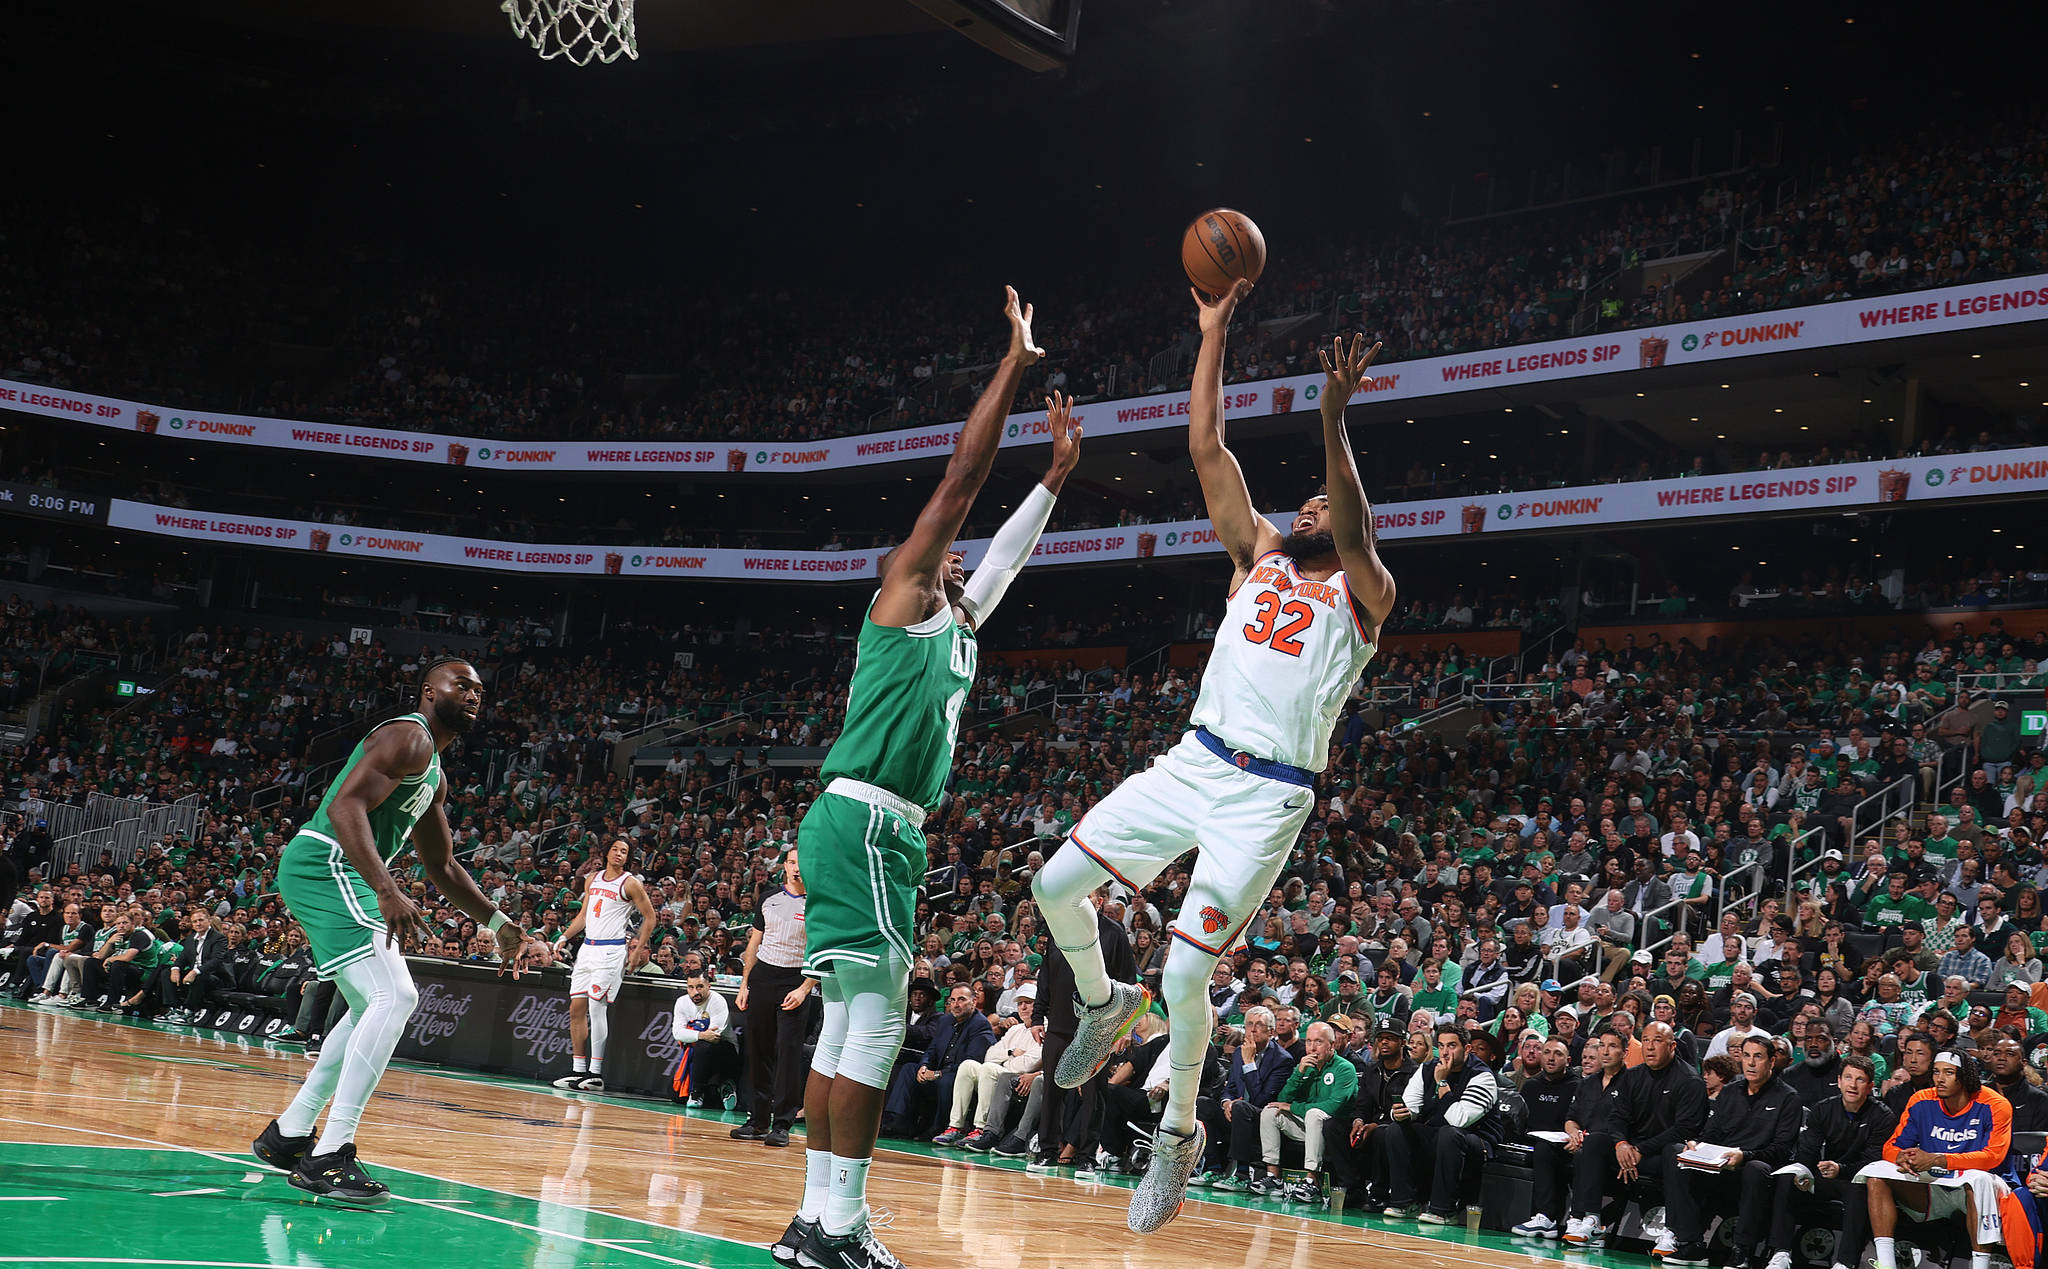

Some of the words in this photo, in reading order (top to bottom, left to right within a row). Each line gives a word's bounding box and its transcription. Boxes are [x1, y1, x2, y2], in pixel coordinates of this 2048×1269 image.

[1205, 215, 1237, 266] Wilson
[1859, 303, 1939, 328] WHERE
[1944, 287, 2048, 316] LEGENDS
[1442, 359, 1502, 382] WHERE
[1506, 350, 1588, 373] LEGENDS
[1593, 345, 1621, 363] SIP
[20, 391, 93, 414] LEGENDS
[96, 404, 121, 419] SIP
[1117, 405, 1166, 423] WHERE
[1235, 392, 1258, 408] SIP
[292, 429, 342, 445] WHERE
[345, 434, 409, 451] LEGENDS
[412, 440, 435, 453] SIP
[856, 440, 896, 456] WHERE
[898, 435, 948, 450] LEGENDS
[587, 450, 631, 462] WHERE
[634, 451, 692, 463] LEGENDS
[695, 451, 715, 463] SIP
[1657, 486, 1725, 508] WHERE
[1729, 479, 1821, 501] LEGENDS
[1825, 475, 1858, 494] SIP
[29, 493, 65, 511] 8:06
[68, 500, 96, 516] PM
[155, 513, 207, 531] WHERE
[210, 520, 273, 538] LEGENDS
[276, 527, 297, 541] SIP
[1421, 509, 1446, 525] SIP
[464, 546, 513, 562] WHERE
[516, 550, 571, 565] LEGENDS
[574, 553, 593, 566] SIP
[1046, 539, 1101, 555] LEGENDS
[1104, 537, 1125, 550] SIP
[744, 557, 790, 570] WHERE
[793, 559, 847, 572] LEGENDS
[849, 558, 867, 571] SIP
[1249, 567, 1293, 592] NEW
[1289, 582, 1339, 609] YORK
[1243, 590, 1315, 658] 32
[119, 682, 134, 694] TD
[2024, 714, 2048, 731] TD
[593, 899, 603, 918] 4
[1930, 1125, 1977, 1142] Knicks
